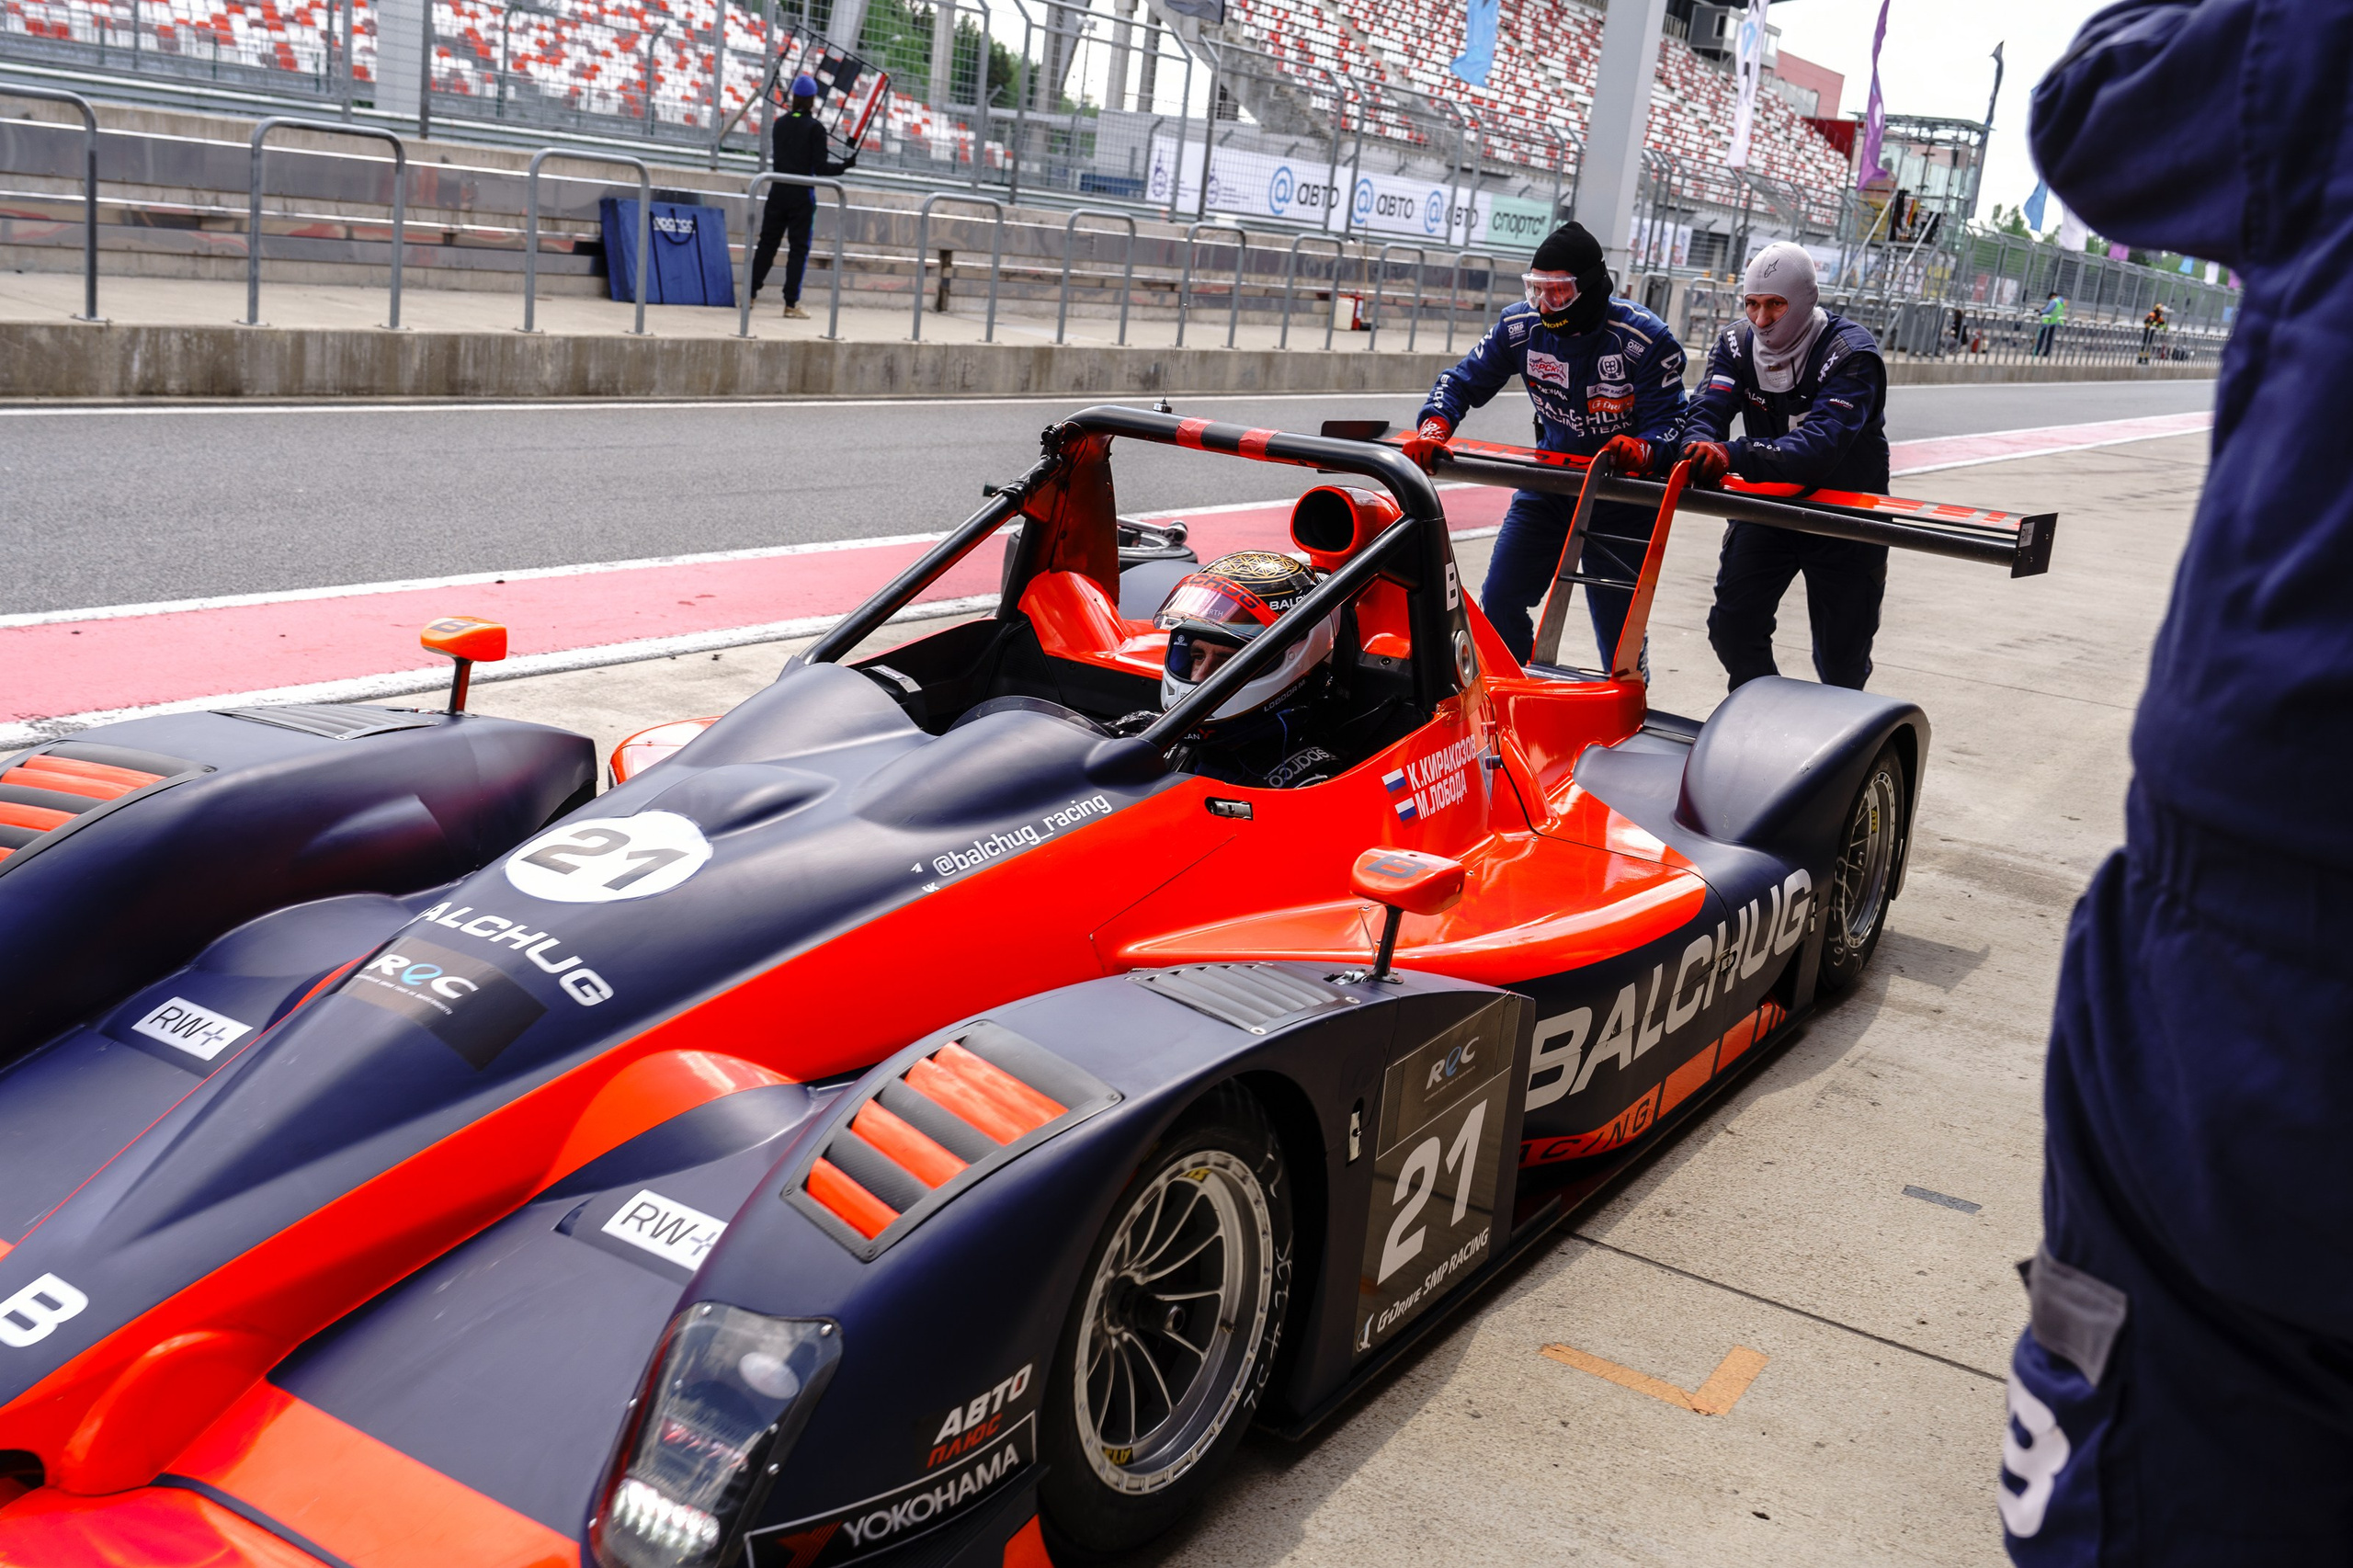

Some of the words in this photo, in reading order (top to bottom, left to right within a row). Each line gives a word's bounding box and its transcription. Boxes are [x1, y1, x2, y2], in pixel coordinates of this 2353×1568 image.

[1507, 322, 1525, 334] OMP
[1627, 340, 1645, 355] OMP
[1726, 329, 1743, 358] HRX
[1817, 351, 1839, 383] HRX
[1445, 562, 1460, 612] B
[1267, 746, 1331, 789] sparco
[1415, 768, 1468, 820] М.ЛОБОДА
[520, 827, 690, 891] 21
[1366, 855, 1429, 879] B
[409, 902, 615, 1007] ALCHUG
[1525, 869, 1813, 1112] BALCHUG
[148, 1005, 226, 1047] RW+
[1377, 1098, 1488, 1286] 21
[1423, 1260, 1449, 1296] SMP
[1448, 1227, 1490, 1275] RACING
[933, 1362, 1033, 1446] АВТО
[926, 1413, 1003, 1469] ПЛЮС
[842, 1442, 1020, 1548] YOKOHAMA
